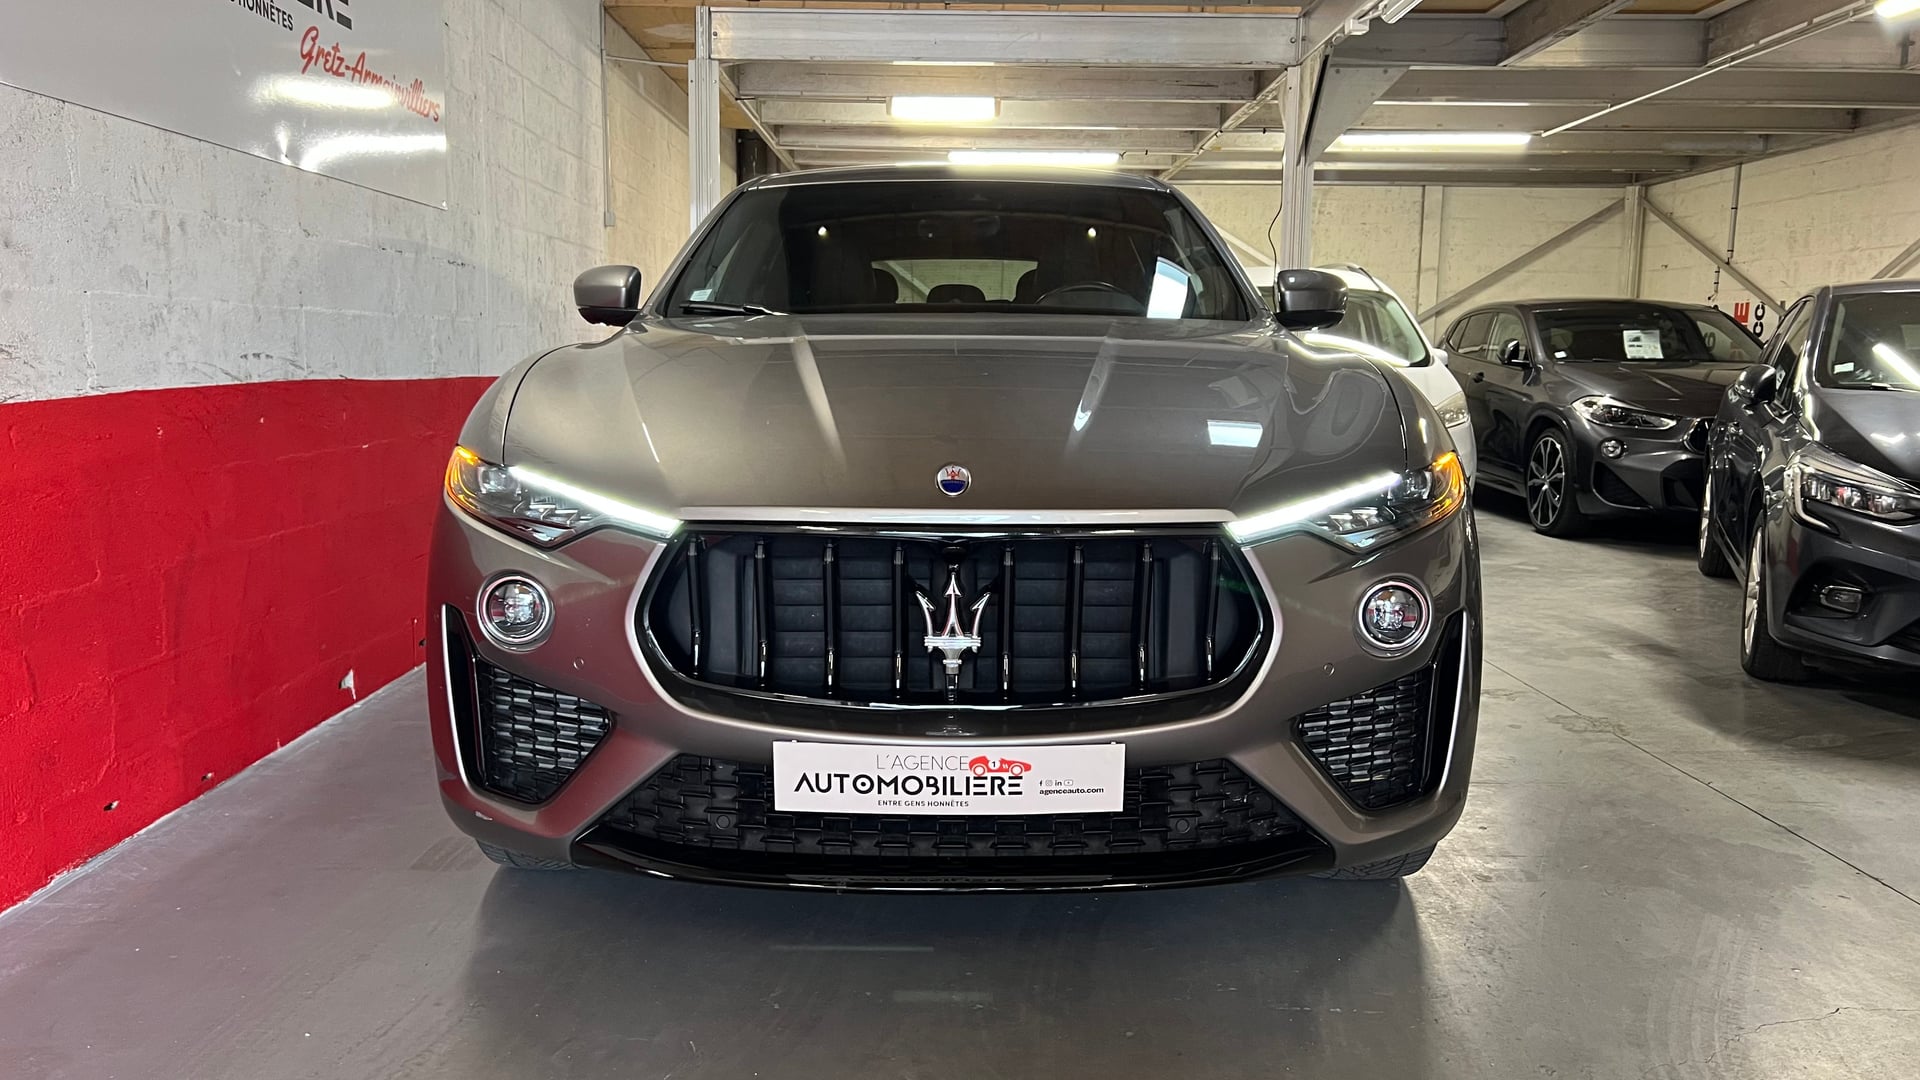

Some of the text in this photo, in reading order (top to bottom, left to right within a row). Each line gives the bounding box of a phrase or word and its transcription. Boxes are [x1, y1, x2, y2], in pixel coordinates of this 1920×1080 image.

[876, 754, 969, 771] L'AGENCE
[1039, 787, 1104, 795] agenceauto.com
[878, 799, 902, 807] ENTRE
[904, 799, 926, 807] GENS
